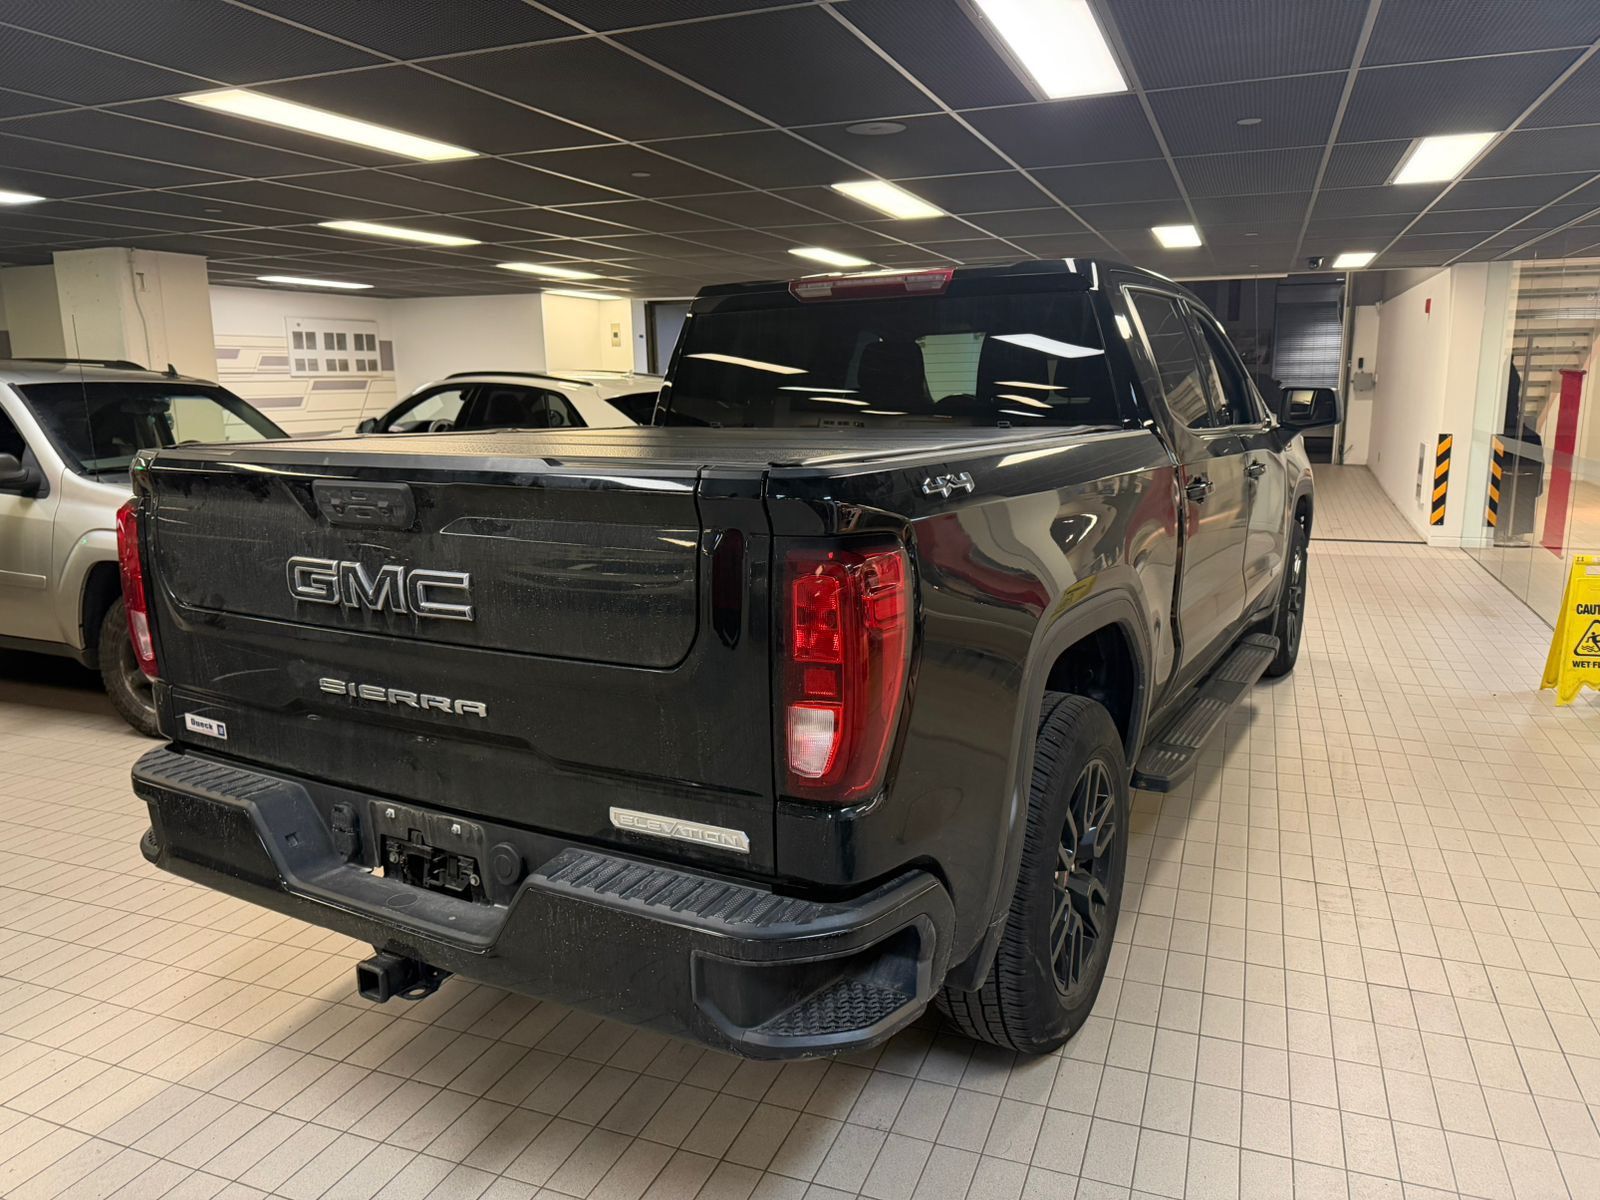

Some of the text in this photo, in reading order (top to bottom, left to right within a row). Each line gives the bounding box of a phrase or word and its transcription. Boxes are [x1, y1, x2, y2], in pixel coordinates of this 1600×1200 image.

[286, 556, 474, 621] GMC
[1572, 661, 1591, 669] WET
[319, 677, 487, 718] SIERRA
[619, 813, 738, 846] ELEVATION
